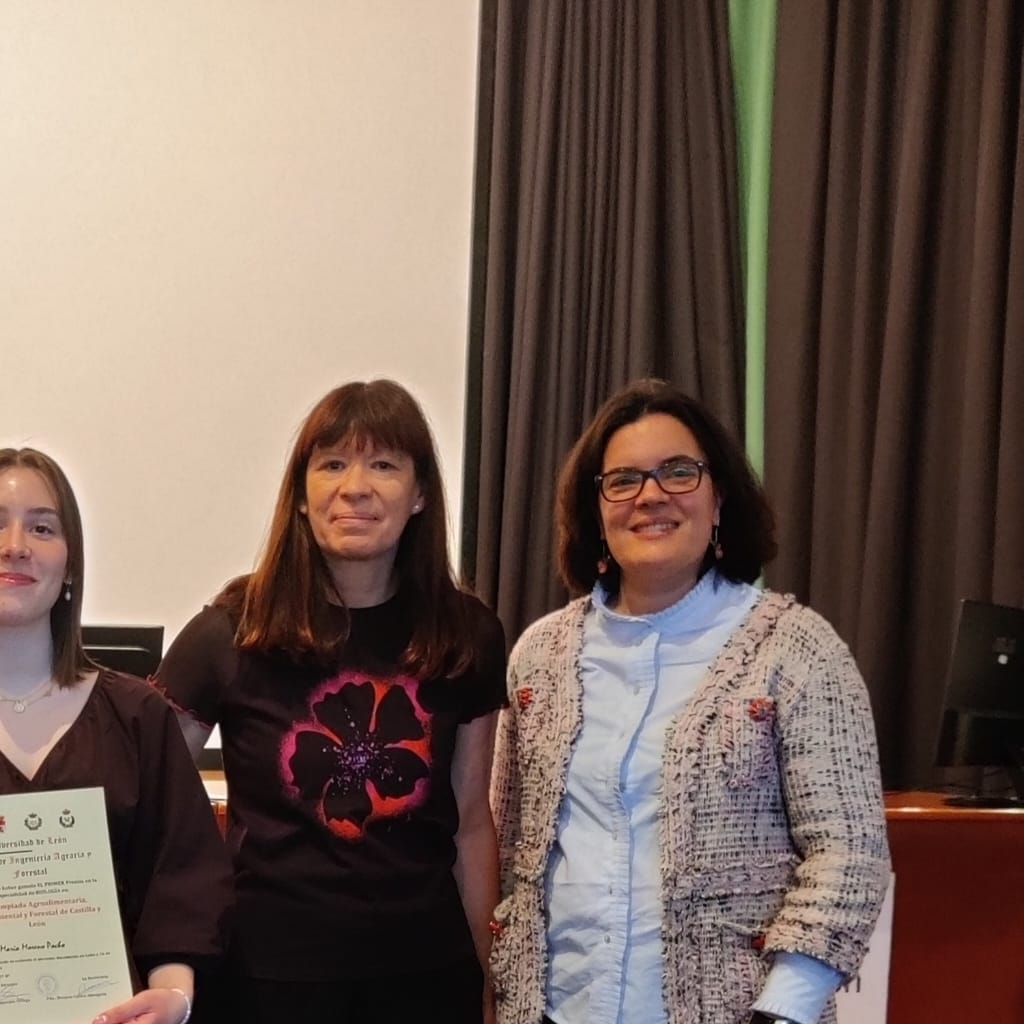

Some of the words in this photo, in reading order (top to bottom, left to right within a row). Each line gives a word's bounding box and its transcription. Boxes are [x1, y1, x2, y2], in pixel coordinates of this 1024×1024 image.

[13, 867, 48, 879] Forestal
[29, 909, 58, 918] Forestal
[69, 906, 96, 915] Castilla
